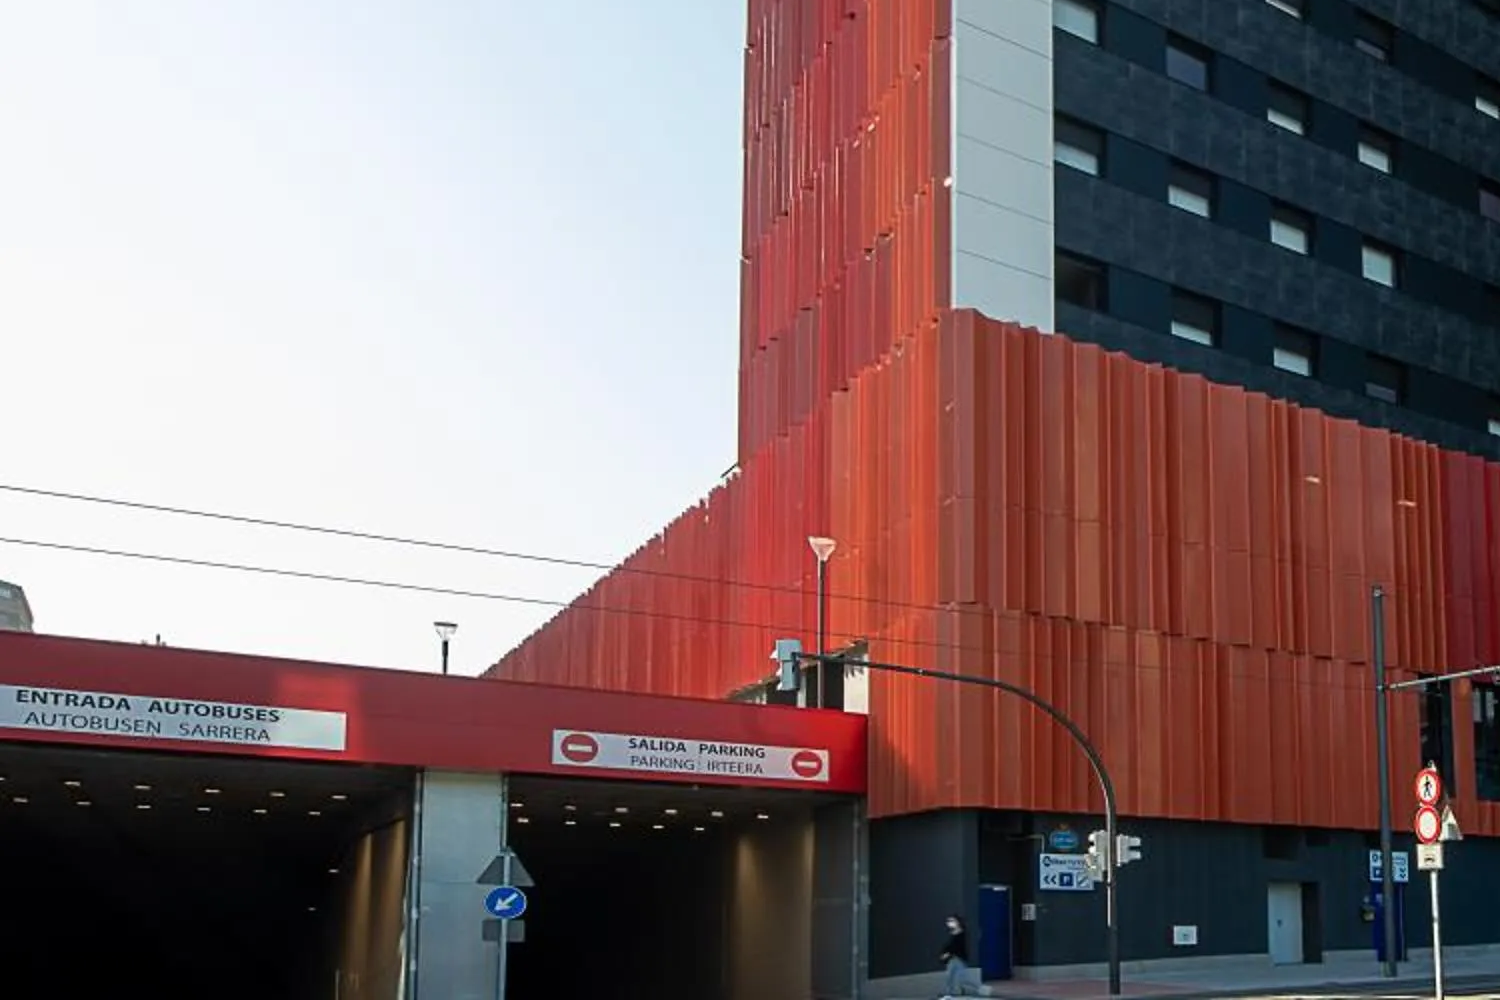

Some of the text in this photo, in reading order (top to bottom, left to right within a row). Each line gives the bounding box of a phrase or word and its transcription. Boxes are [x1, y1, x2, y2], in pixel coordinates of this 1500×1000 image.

[15, 688, 281, 723] ENTRADA AUTOBUSES
[24, 711, 271, 742] AUTOBUSEN SARRERA
[628, 737, 766, 759] SALIDA PARKING
[630, 755, 764, 775] PARKING IRTEERA
